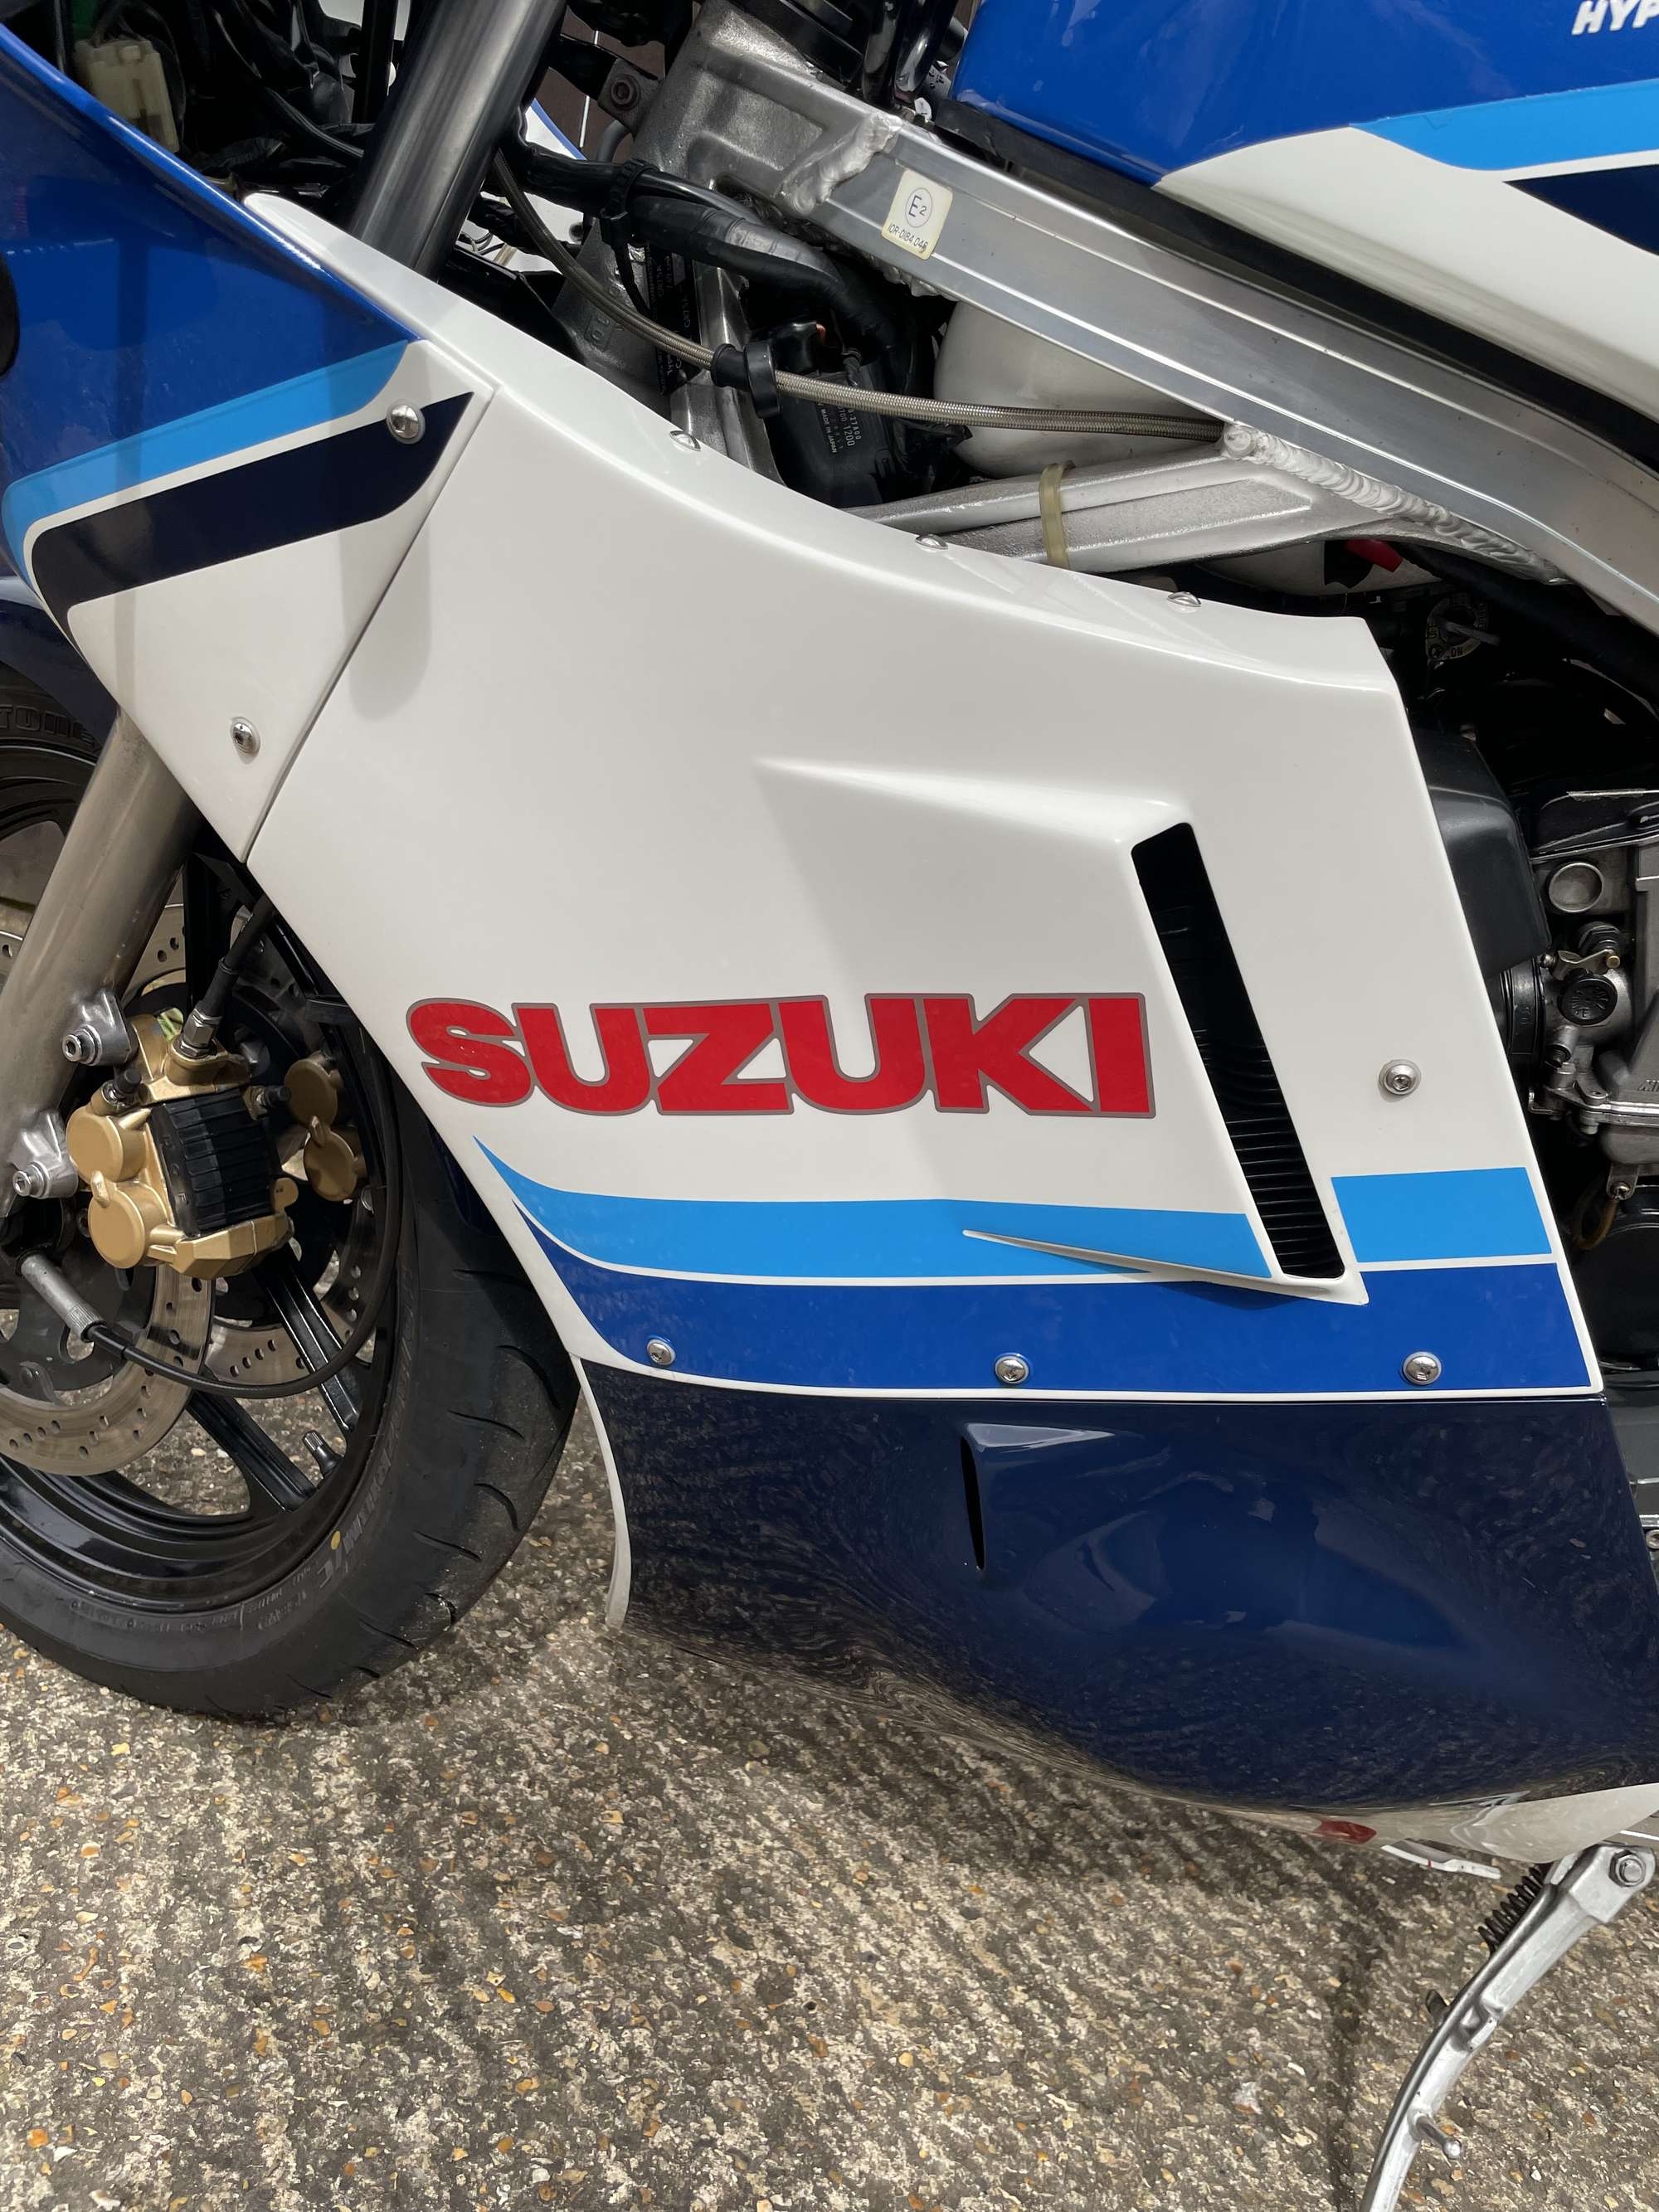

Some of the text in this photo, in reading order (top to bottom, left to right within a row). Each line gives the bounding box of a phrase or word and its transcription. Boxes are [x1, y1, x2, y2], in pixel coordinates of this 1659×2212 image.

[821, 409, 830, 425] MADE
[828, 434, 838, 453] JAPAN
[843, 425, 856, 446] 1200
[406, 993, 1156, 1118] SUZUKI
